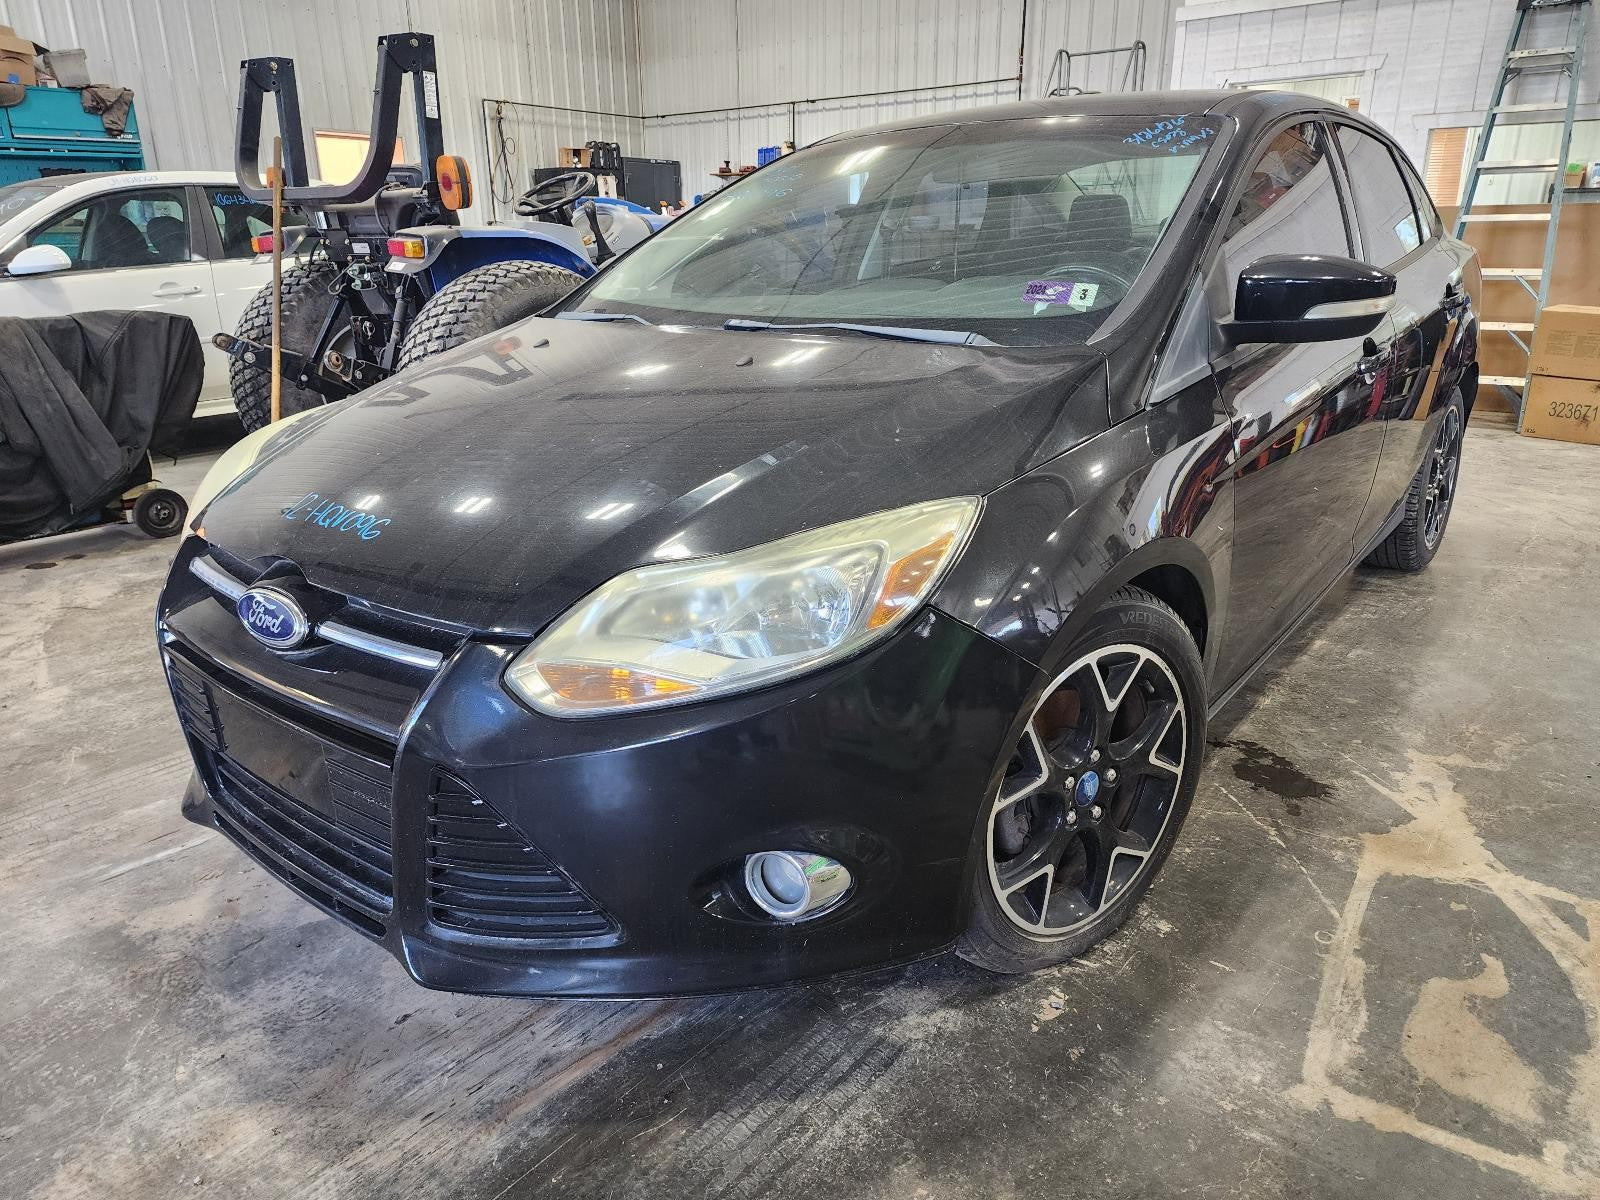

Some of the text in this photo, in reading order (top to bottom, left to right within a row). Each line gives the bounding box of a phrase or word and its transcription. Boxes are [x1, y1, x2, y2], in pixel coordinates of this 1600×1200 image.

[1025, 284, 1047, 296] 2024
[1079, 288, 1089, 301] 3
[1548, 401, 1599, 421] 323671
[248, 593, 284, 634] Ford
